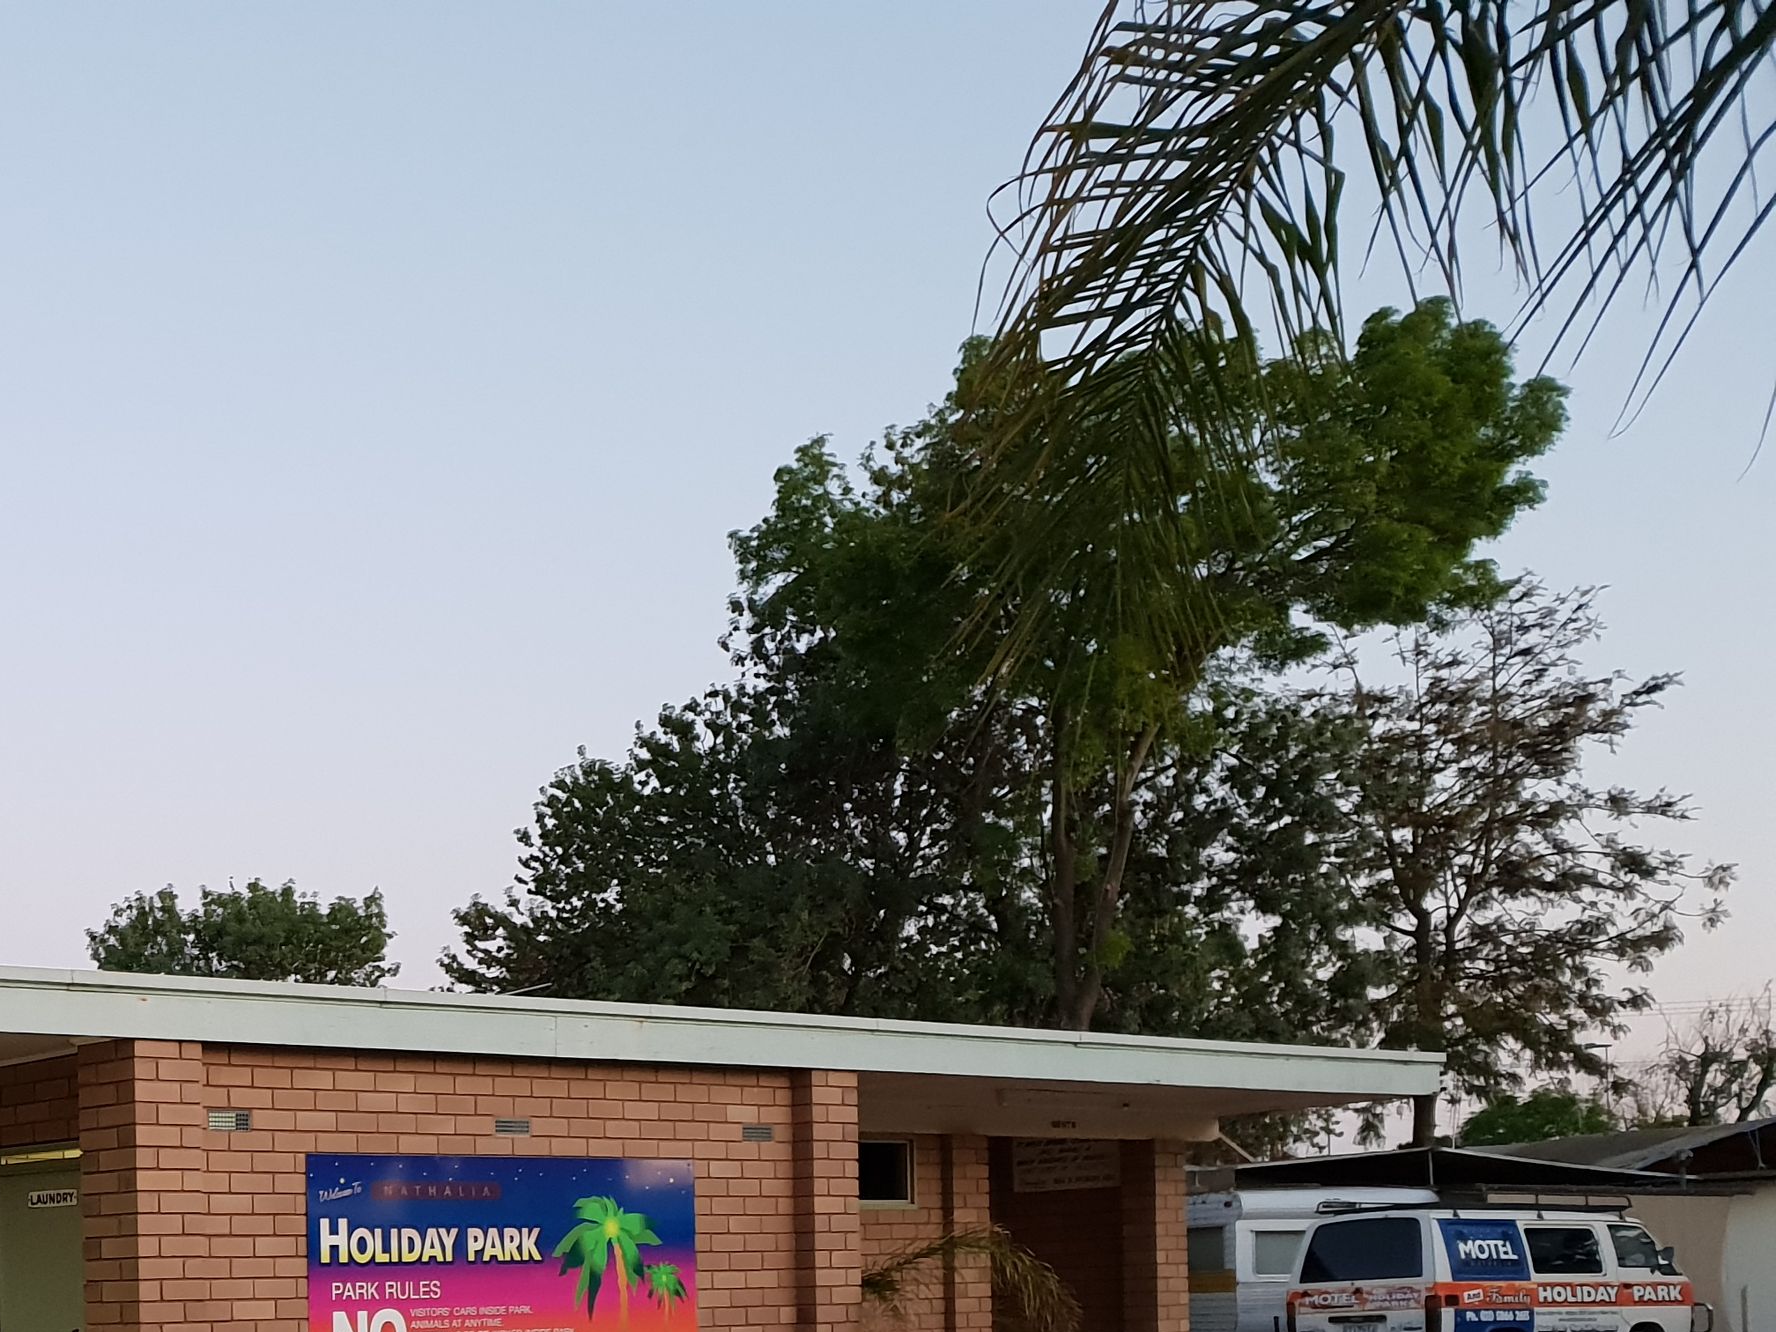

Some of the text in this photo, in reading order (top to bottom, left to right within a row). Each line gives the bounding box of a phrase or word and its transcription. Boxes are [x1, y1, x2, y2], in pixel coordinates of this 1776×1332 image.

[352, 1181, 362, 1195] To
[384, 1184, 492, 1198] NATHALIA
[30, 1192, 75, 1206] LAUNDRY
[319, 1217, 543, 1264] HOLIDAY PARK
[1457, 1240, 1519, 1260] MOTEL
[331, 1280, 441, 1300] PARK RULES
[1369, 1292, 1420, 1302] HOLIDAY
[1486, 1288, 1530, 1304] Family
[1538, 1286, 1619, 1303] HOLIDAY
[1632, 1285, 1684, 1302] PARK
[1305, 1292, 1360, 1305] MOTEL
[453, 1306, 477, 1316] CARS
[479, 1305, 507, 1315] INSIDE
[410, 1319, 450, 1329] ANIMALS
[452, 1319, 462, 1328] AT
